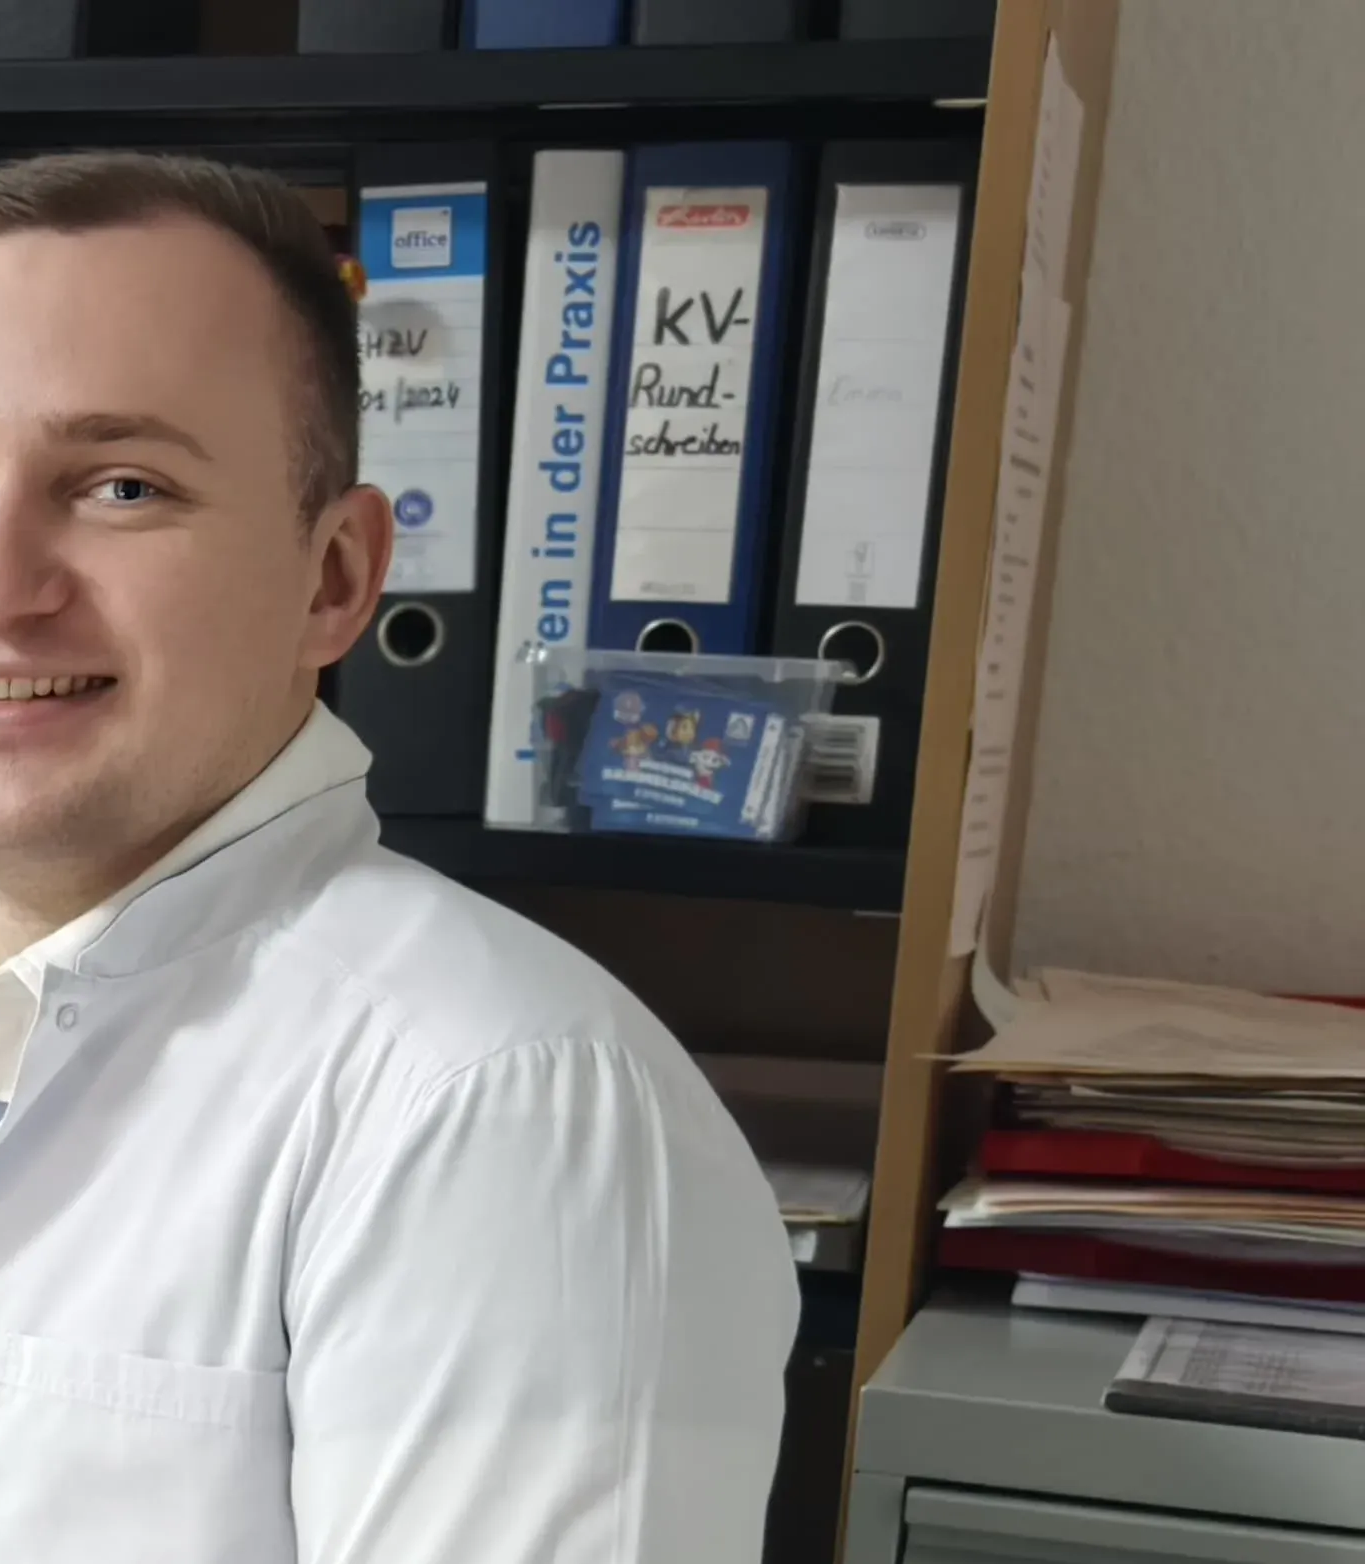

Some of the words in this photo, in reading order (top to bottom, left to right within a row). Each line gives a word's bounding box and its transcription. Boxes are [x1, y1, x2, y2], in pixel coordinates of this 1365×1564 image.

[394, 231, 448, 249] office
[545, 220, 602, 386] Praxis
[654, 286, 750, 346] KV-
[631, 361, 736, 410] Rund-
[538, 404, 586, 493] der
[625, 418, 742, 457] schreiben
[531, 513, 578, 558] in
